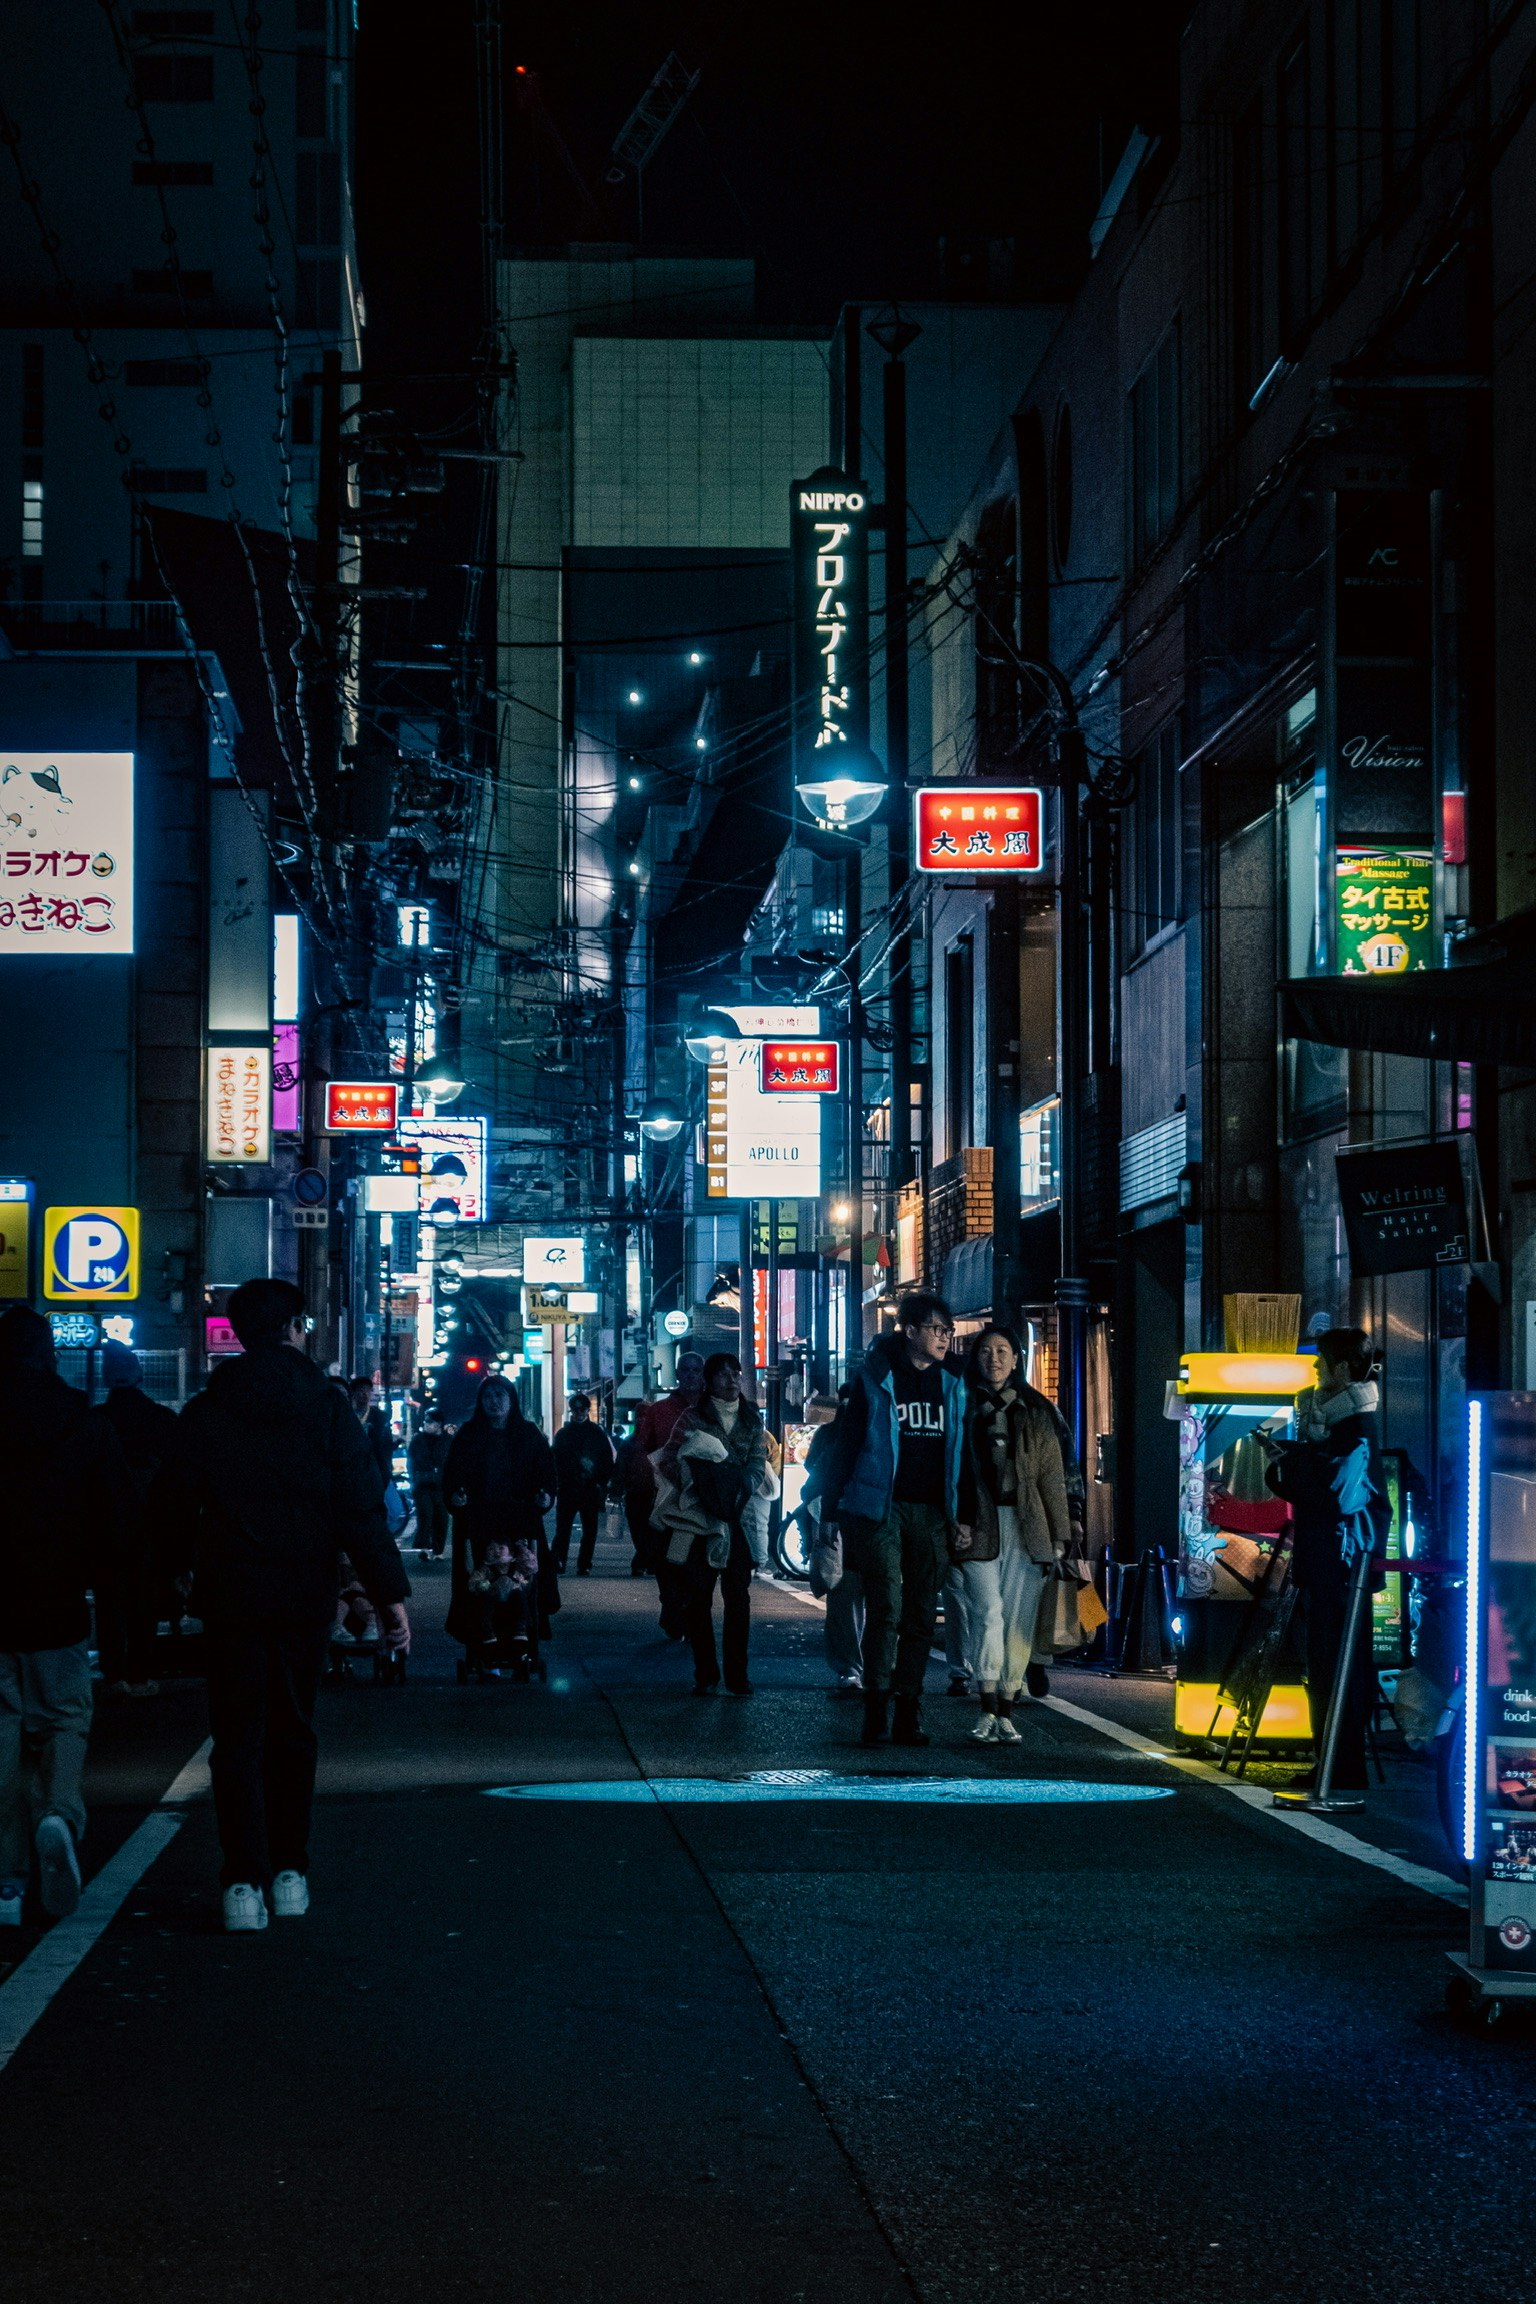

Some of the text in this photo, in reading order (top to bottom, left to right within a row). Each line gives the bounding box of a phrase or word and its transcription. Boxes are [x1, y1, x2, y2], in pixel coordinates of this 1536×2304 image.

[799, 492, 864, 511] NIPPO
[1341, 734, 1424, 769] Vision
[930, 831, 1029, 855] 大成閣
[0, 851, 91, 877] ラオケ
[1342, 857, 1430, 868] Traditional Thai
[1361, 867, 1410, 879] Massage
[1341, 885, 1430, 910] タイ古式
[1341, 912, 1429, 931] マッサージ
[242, 1072, 260, 1142] カラオケ
[712, 1144, 725, 1156] 1F
[749, 1146, 799, 1161] APOLLO
[1359, 1184, 1448, 1207] Welring
[1383, 1212, 1429, 1226] Hair
[1378, 1225, 1437, 1240] Salon
[69, 1221, 121, 1283] P
[1448, 1246, 1464, 1258] 2F
[1503, 1688, 1532, 1703] drink
[1503, 1709, 1530, 1723] food
